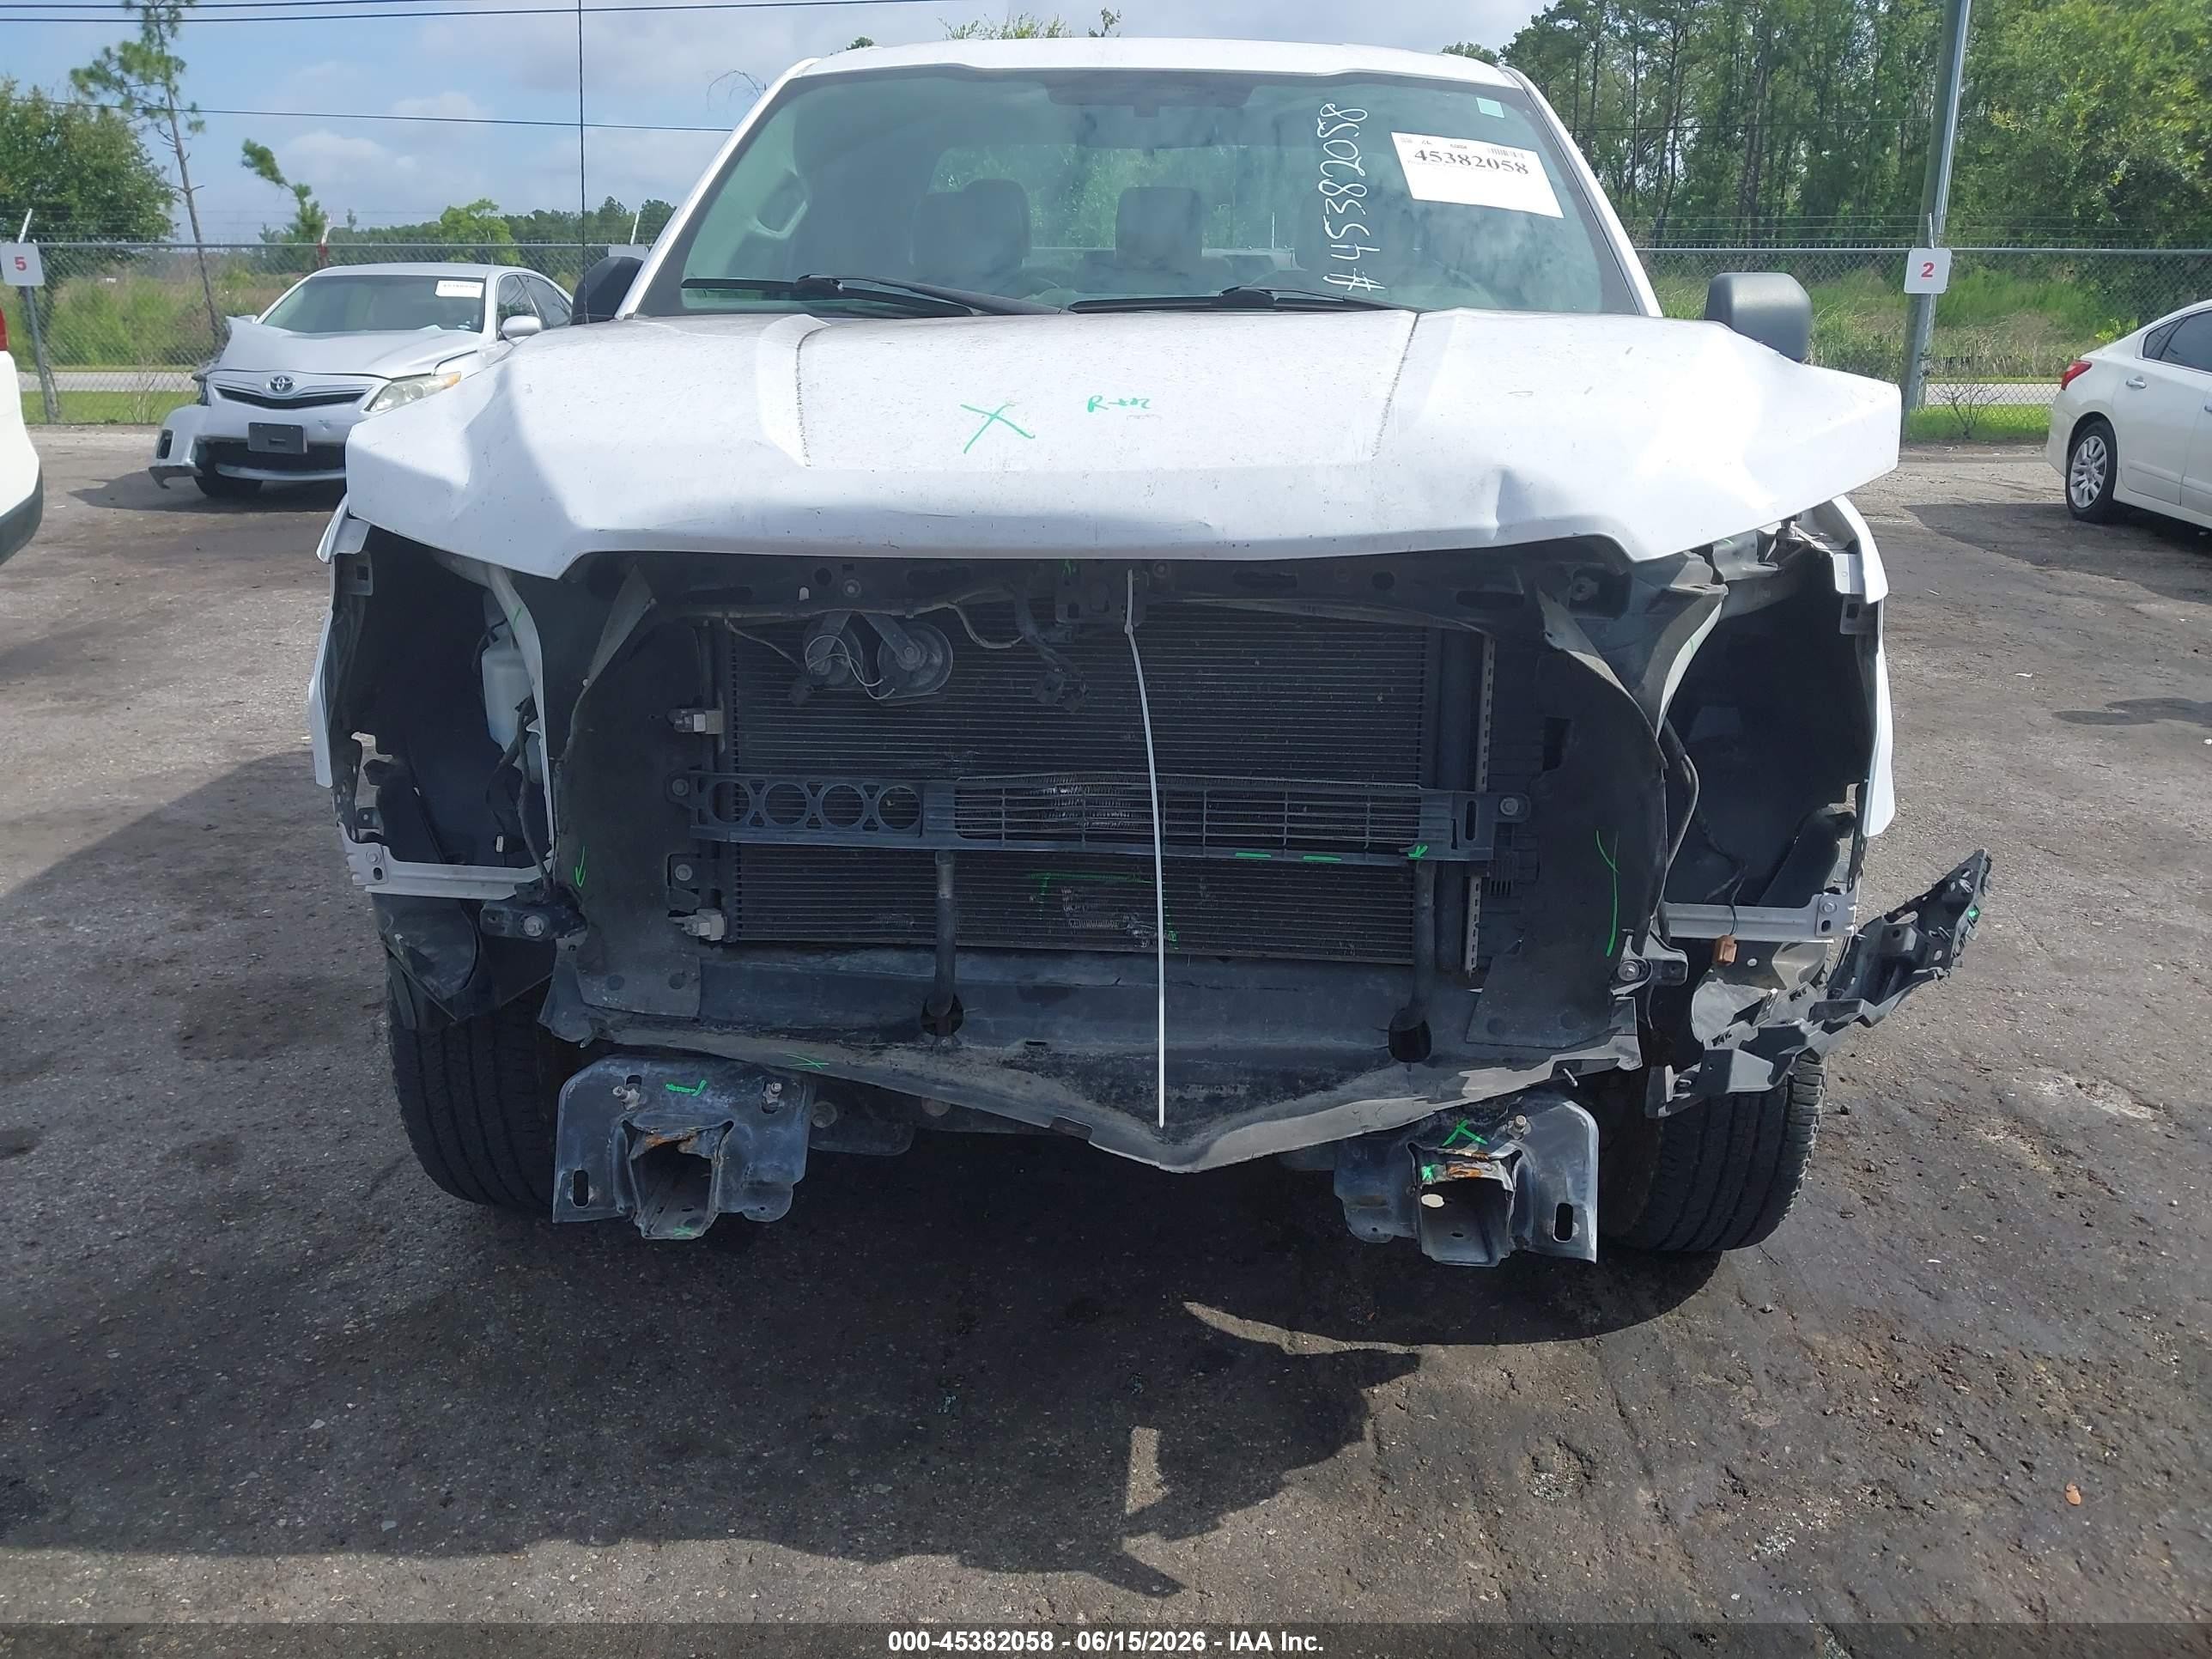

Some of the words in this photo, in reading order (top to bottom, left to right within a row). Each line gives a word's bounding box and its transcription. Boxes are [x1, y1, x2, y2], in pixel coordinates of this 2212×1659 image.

[1414, 149, 1529, 175] 45382058
[14, 256, 27, 271] 5
[1920, 261, 1936, 278] 2
